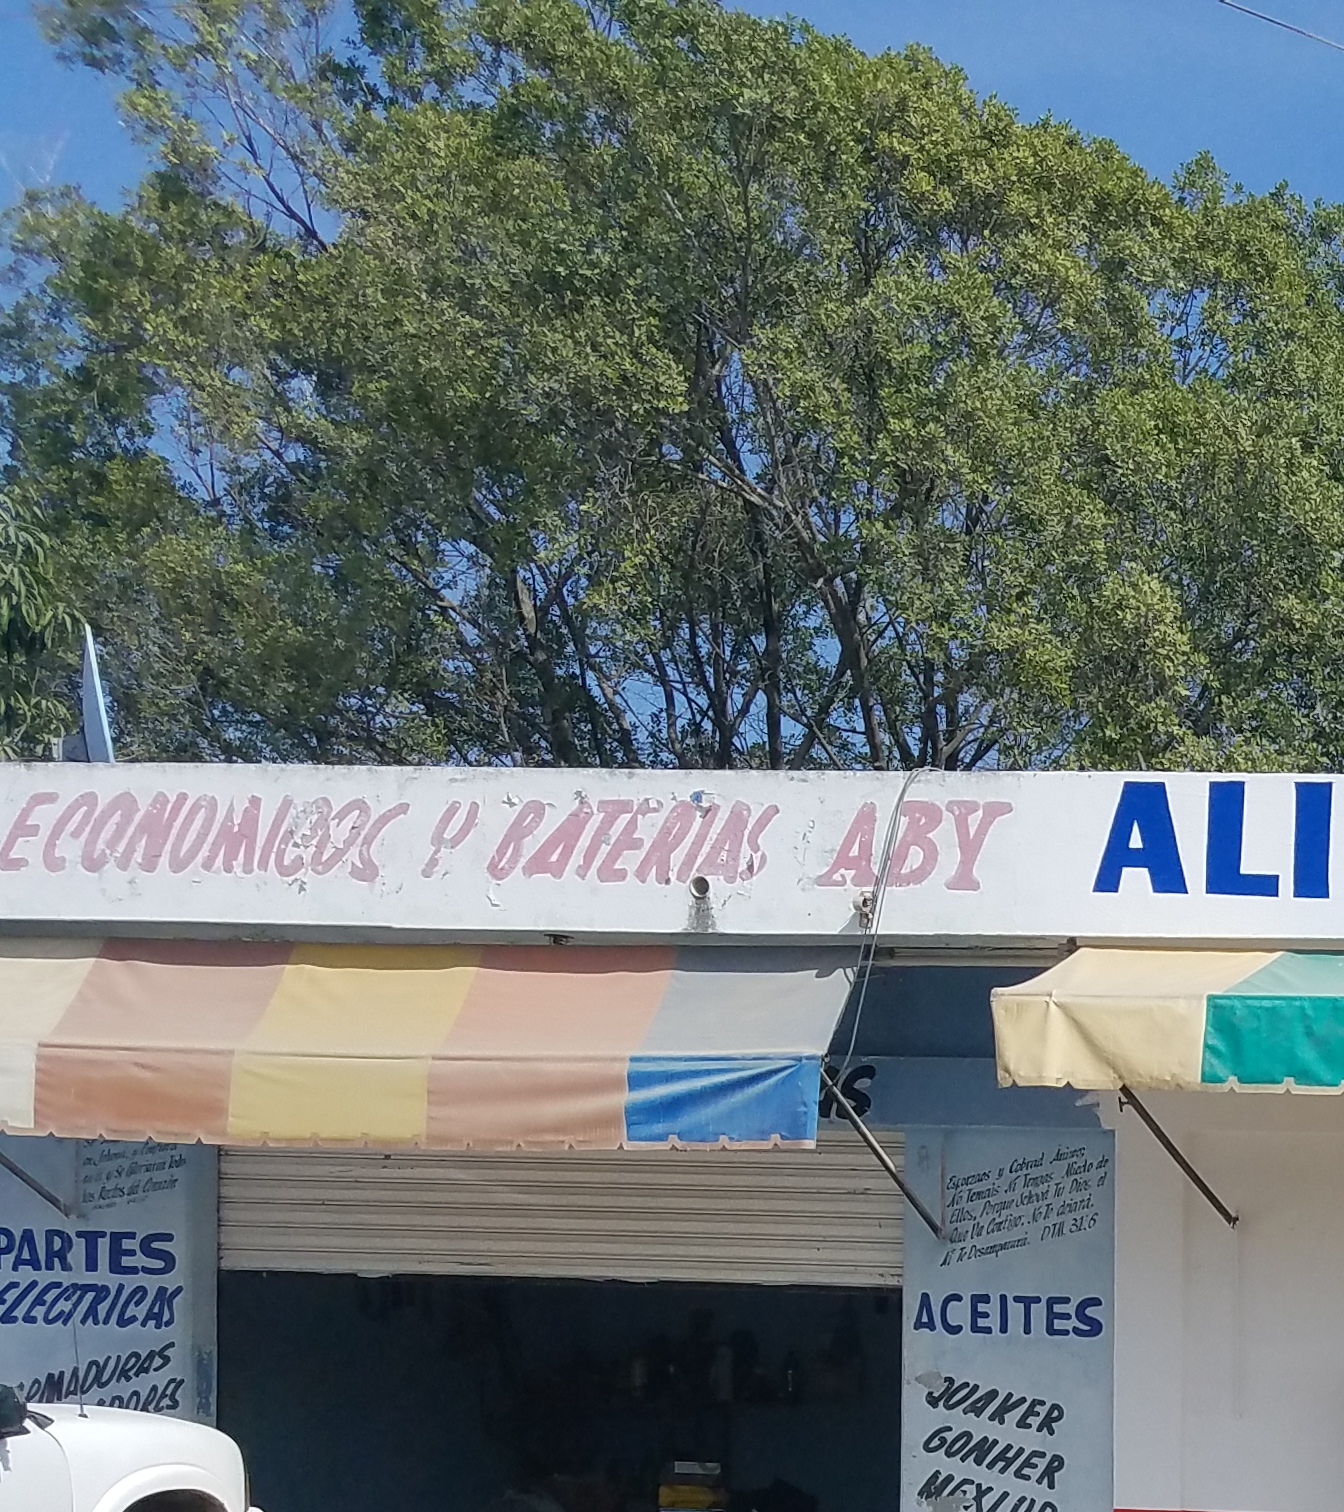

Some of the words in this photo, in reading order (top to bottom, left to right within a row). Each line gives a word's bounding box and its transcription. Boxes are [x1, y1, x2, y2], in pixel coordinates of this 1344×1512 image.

[0, 791, 411, 883] ECONOMICOS
[421, 801, 480, 879] Y
[487, 799, 780, 886] BATERIAS
[815, 800, 1014, 891] ABY
[1008, 1151, 1045, 1174] Cobrad
[1095, 1154, 1110, 1171] de
[979, 1196, 1015, 1221] Porque
[1053, 1181, 1066, 1199] Tu
[1068, 1176, 1092, 1195] Dios
[0, 1227, 176, 1276] PARTES
[913, 1292, 1104, 1337] ACEITES
[922, 1425, 1064, 1490] GONHER
